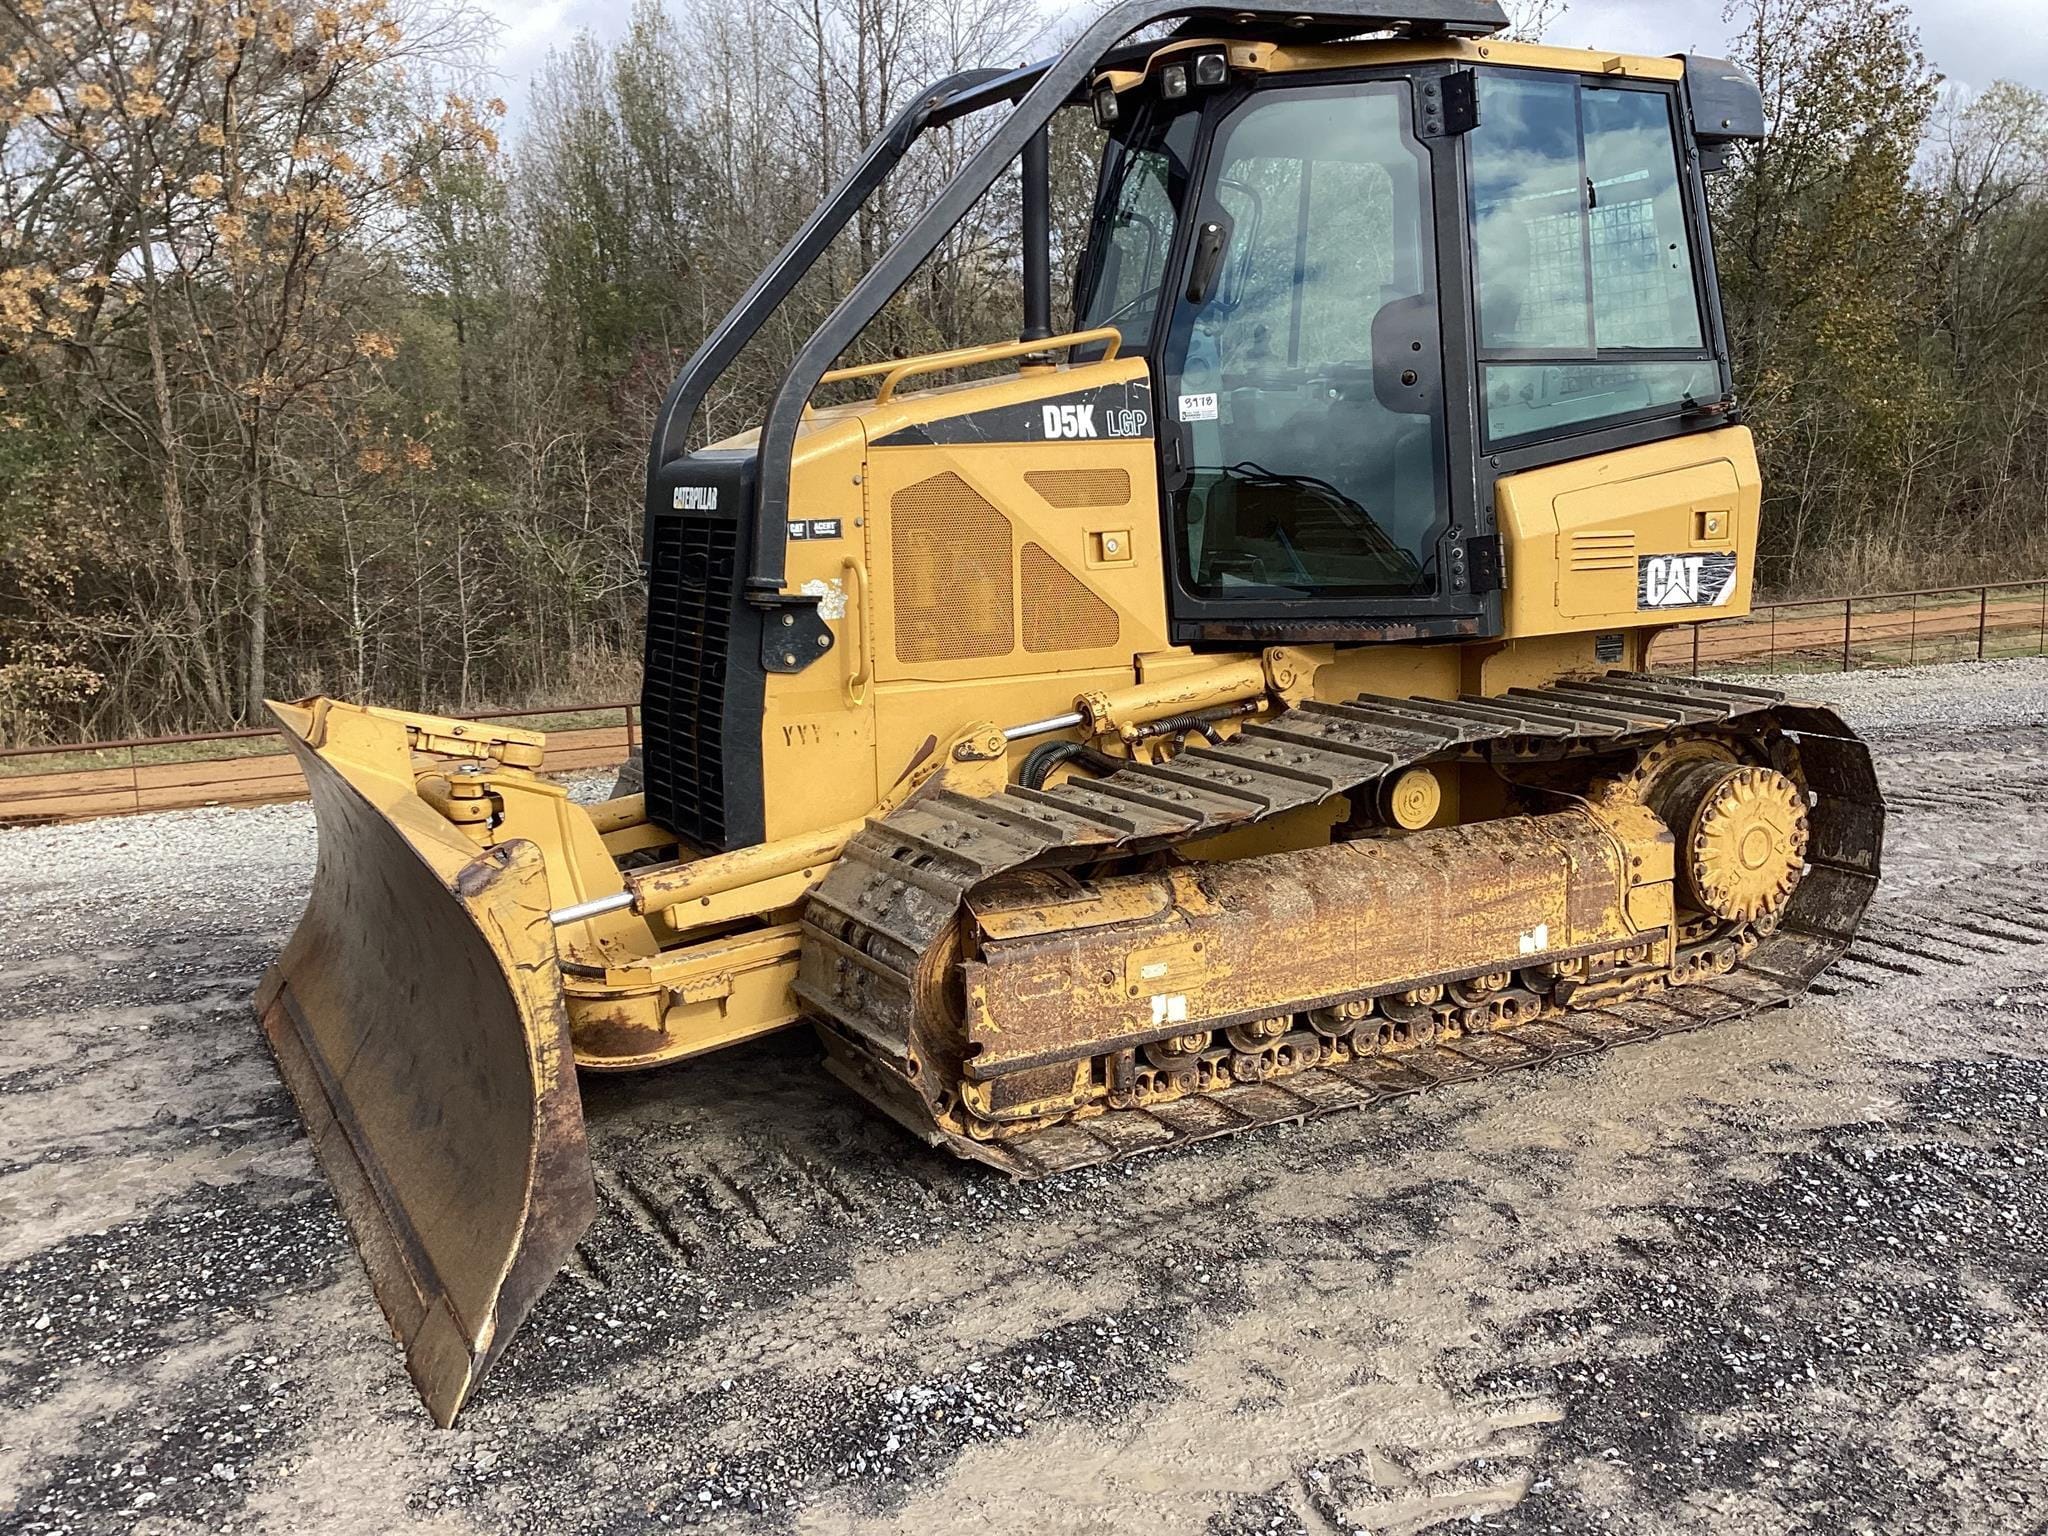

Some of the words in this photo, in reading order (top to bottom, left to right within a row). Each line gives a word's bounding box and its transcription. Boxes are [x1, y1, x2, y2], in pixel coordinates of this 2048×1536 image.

[1042, 404, 1098, 439] D5K
[1106, 409, 1147, 437] LGP
[673, 486, 718, 510] CATERPILLAR
[1646, 557, 1704, 606] CAT
